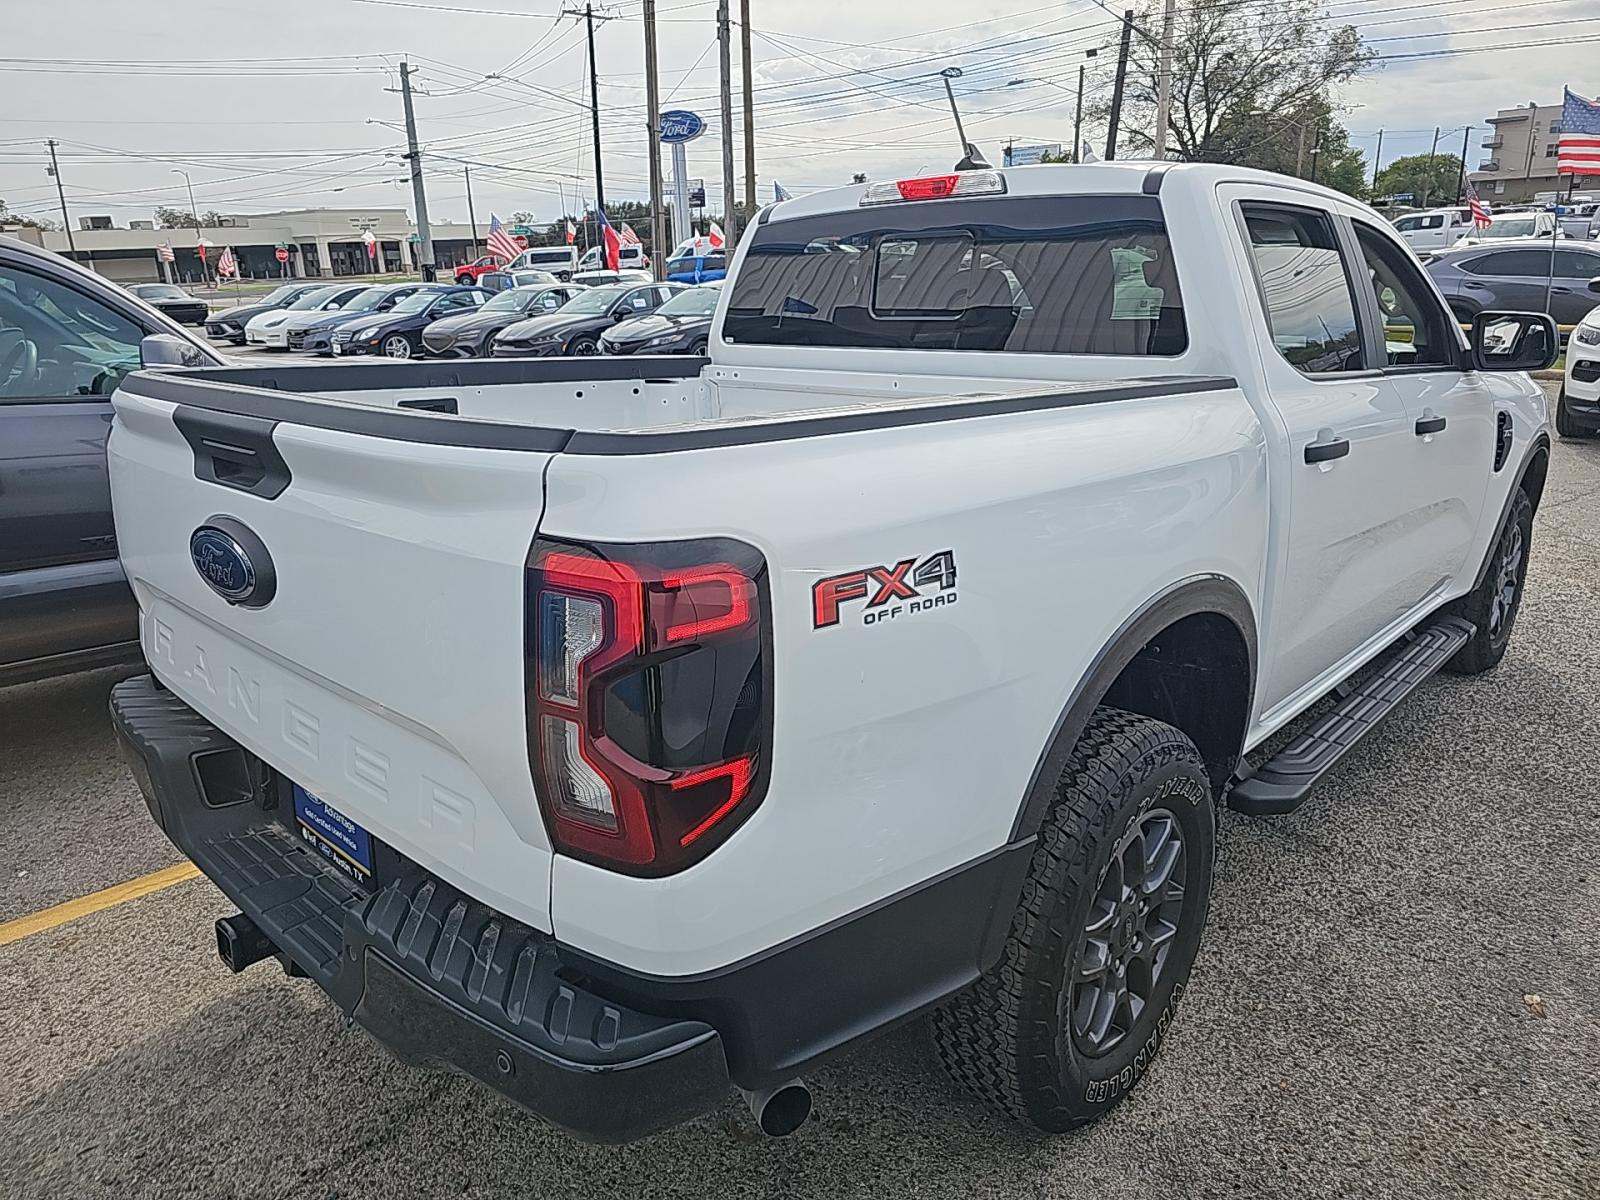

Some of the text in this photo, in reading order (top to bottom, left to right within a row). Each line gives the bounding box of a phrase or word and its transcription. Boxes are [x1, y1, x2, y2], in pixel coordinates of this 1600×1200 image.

[660, 118, 690, 138] Ford
[194, 543, 234, 587] Ford
[812, 550, 957, 630] FX4
[864, 592, 957, 625] OFF ROAD
[153, 617, 476, 855] RANGER
[353, 867, 364, 884] TX
[1086, 983, 1185, 1102] WRANGLER
